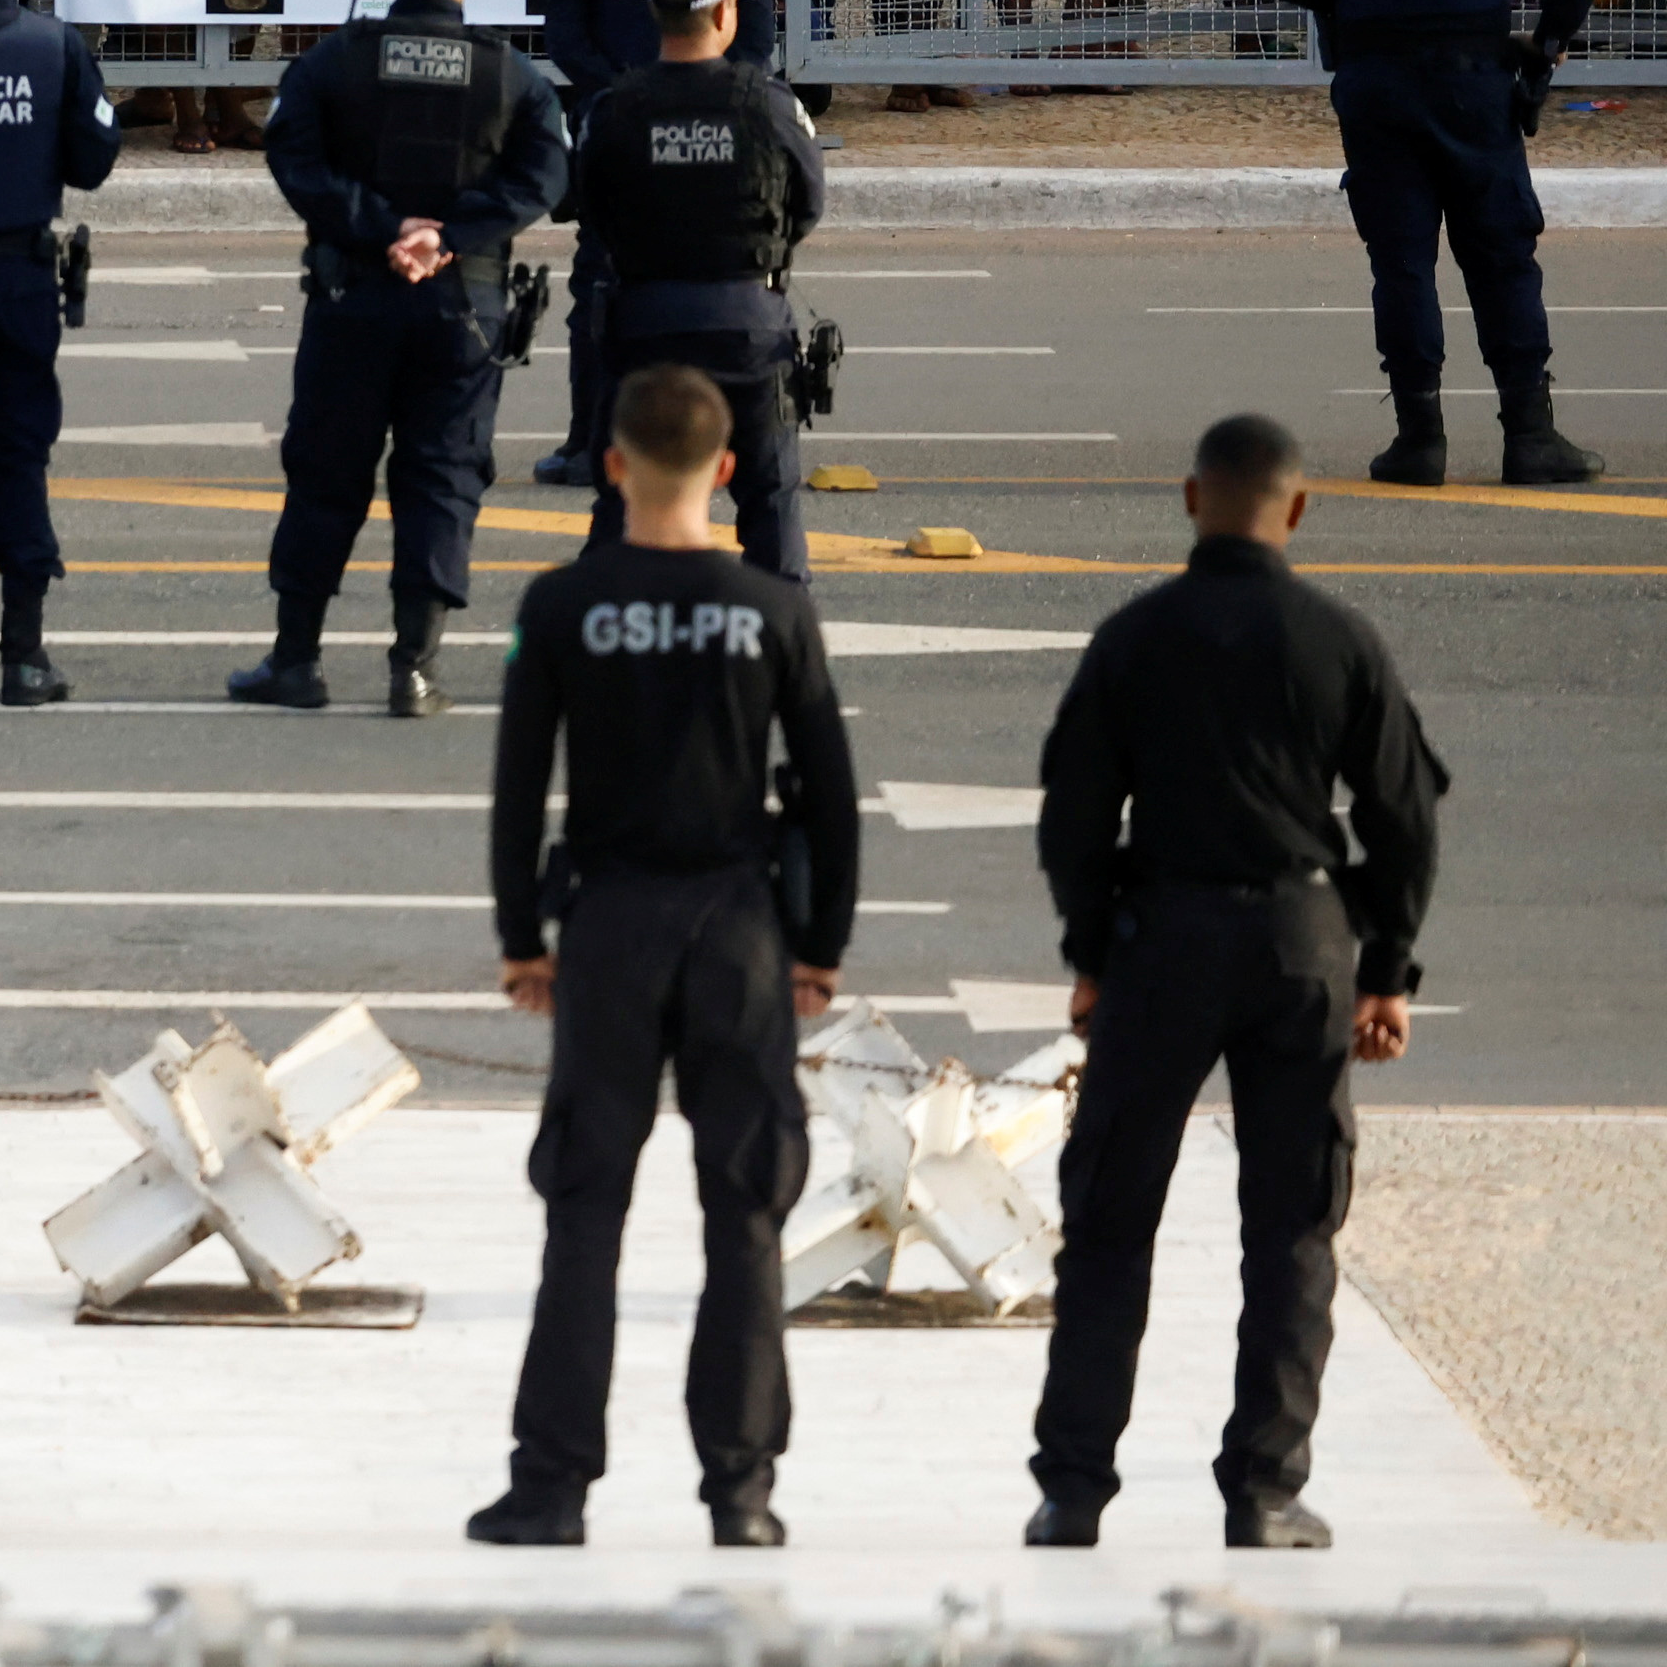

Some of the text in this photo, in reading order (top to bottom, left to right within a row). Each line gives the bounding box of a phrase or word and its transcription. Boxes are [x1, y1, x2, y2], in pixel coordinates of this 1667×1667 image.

[386, 37, 465, 62] POLÍCIA
[386, 58, 465, 80] MILITAR
[651, 119, 734, 144] POLÍCIA
[651, 142, 736, 165] MILITAR
[582, 600, 765, 660] GSI-PR
